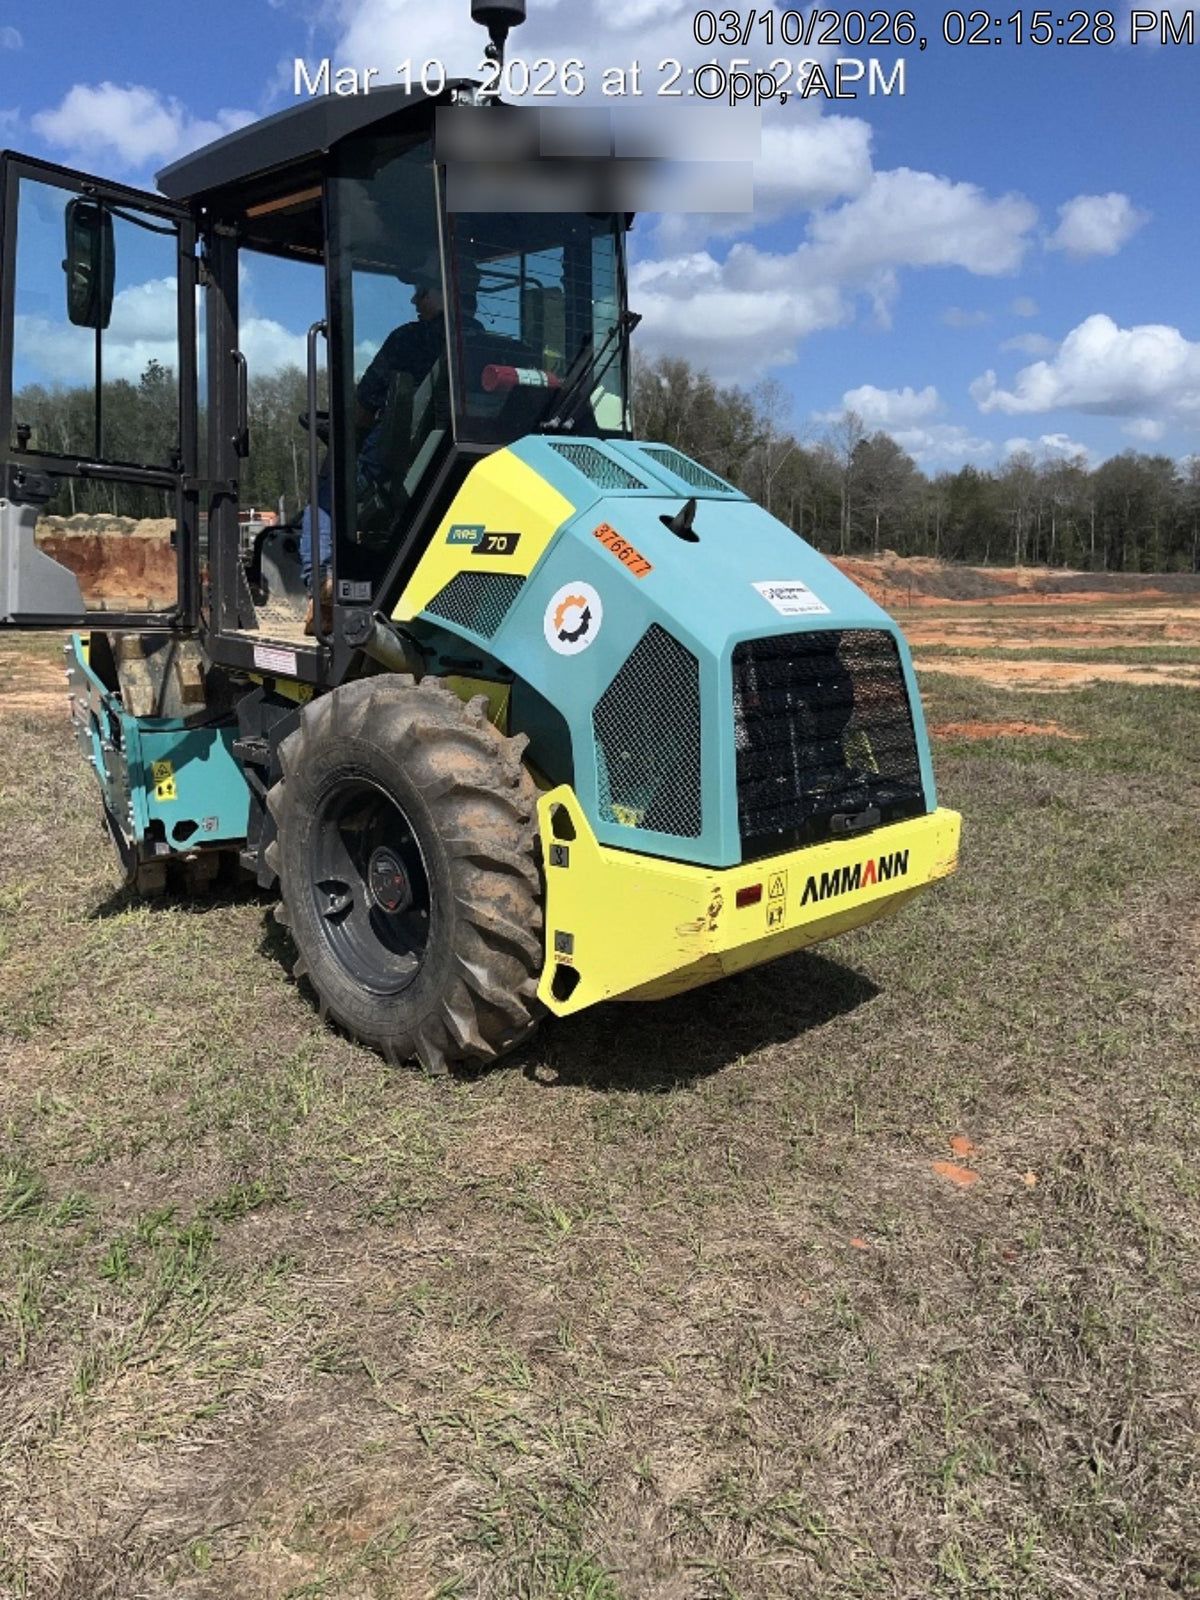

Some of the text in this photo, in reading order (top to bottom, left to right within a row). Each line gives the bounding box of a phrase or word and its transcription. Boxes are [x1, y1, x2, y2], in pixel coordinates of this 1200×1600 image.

[487, 536, 508, 551] 70
[592, 522, 652, 573] 376677
[800, 849, 909, 907] AMMANN
